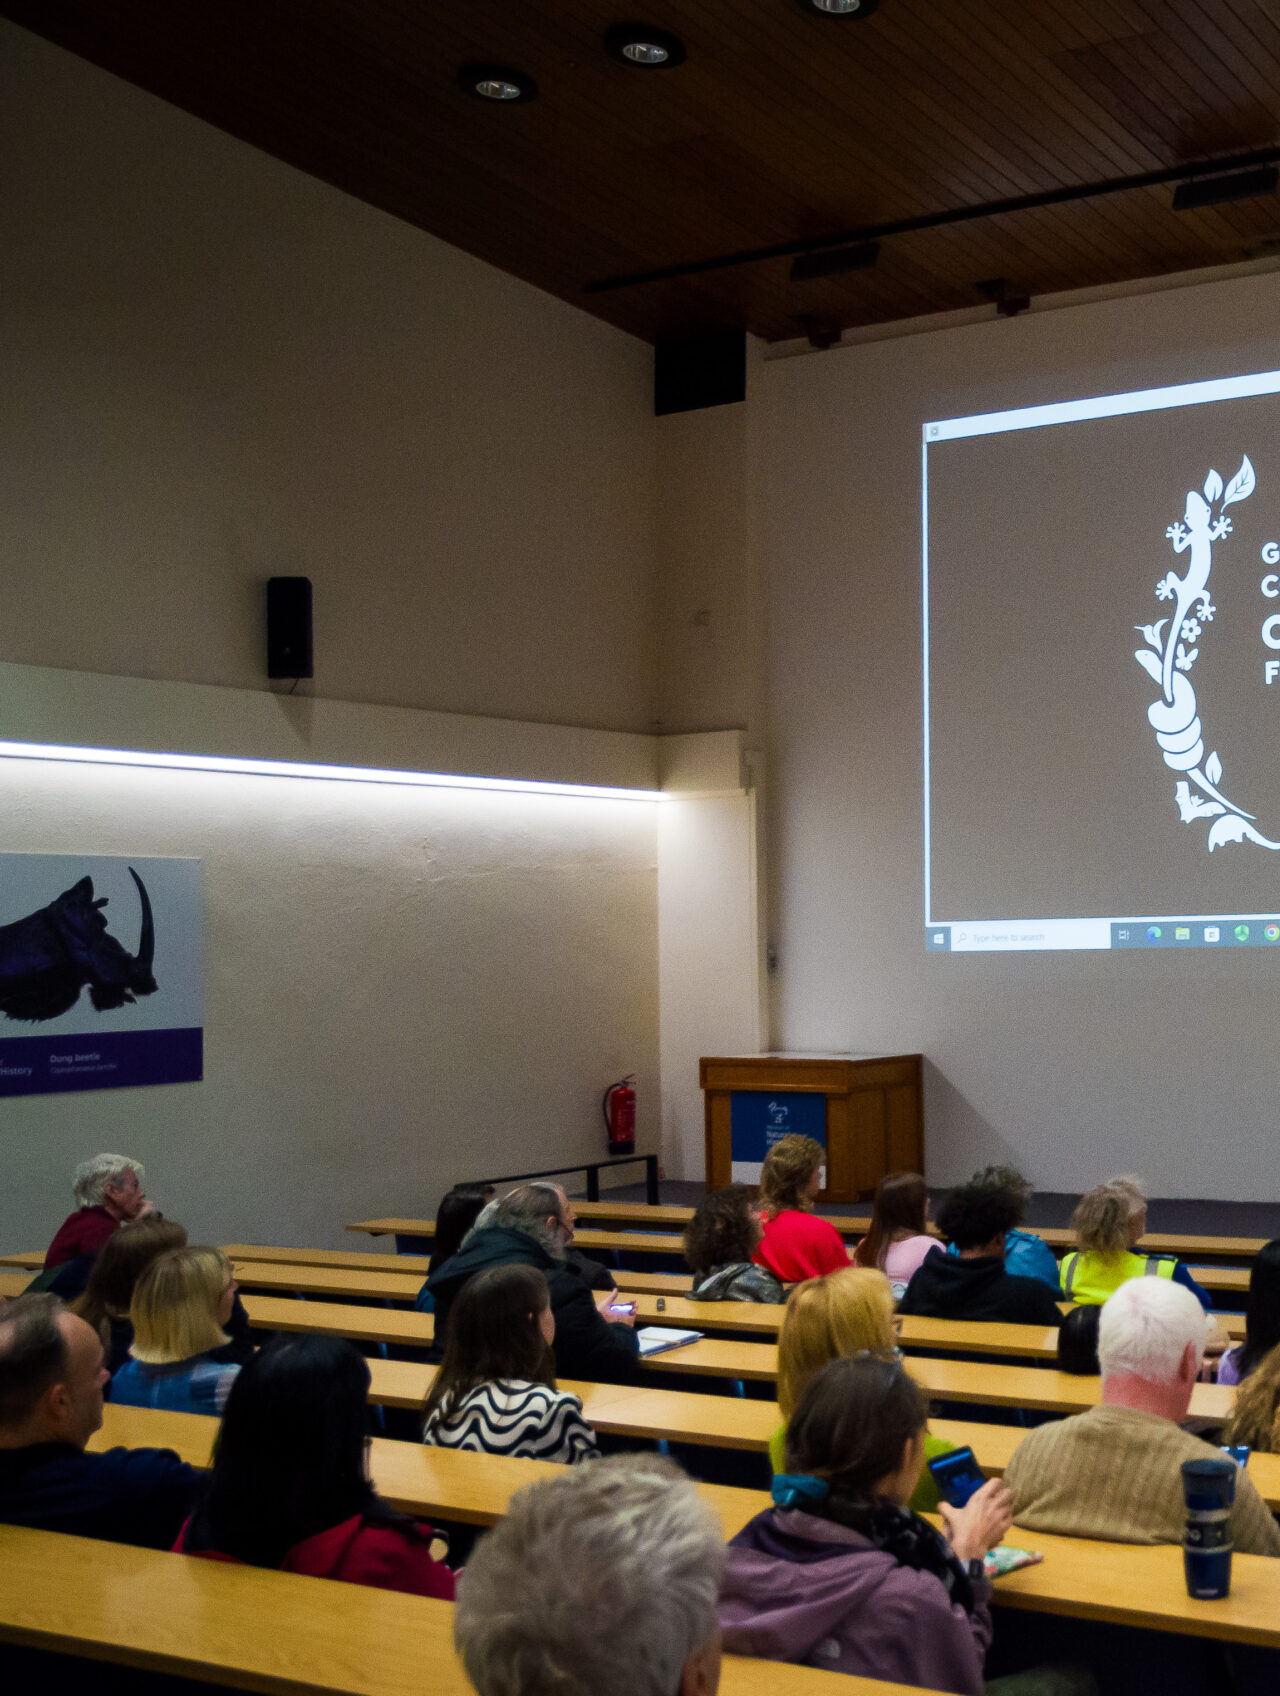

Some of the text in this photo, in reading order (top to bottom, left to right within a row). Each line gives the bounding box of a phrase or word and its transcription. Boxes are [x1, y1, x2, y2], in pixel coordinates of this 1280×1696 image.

[991, 933, 1008, 942] here
[1010, 933, 1018, 941] to
[1019, 933, 1045, 941] search
[49, 1052, 101, 1064] Dung beetle
[0, 1066, 32, 1076] History
